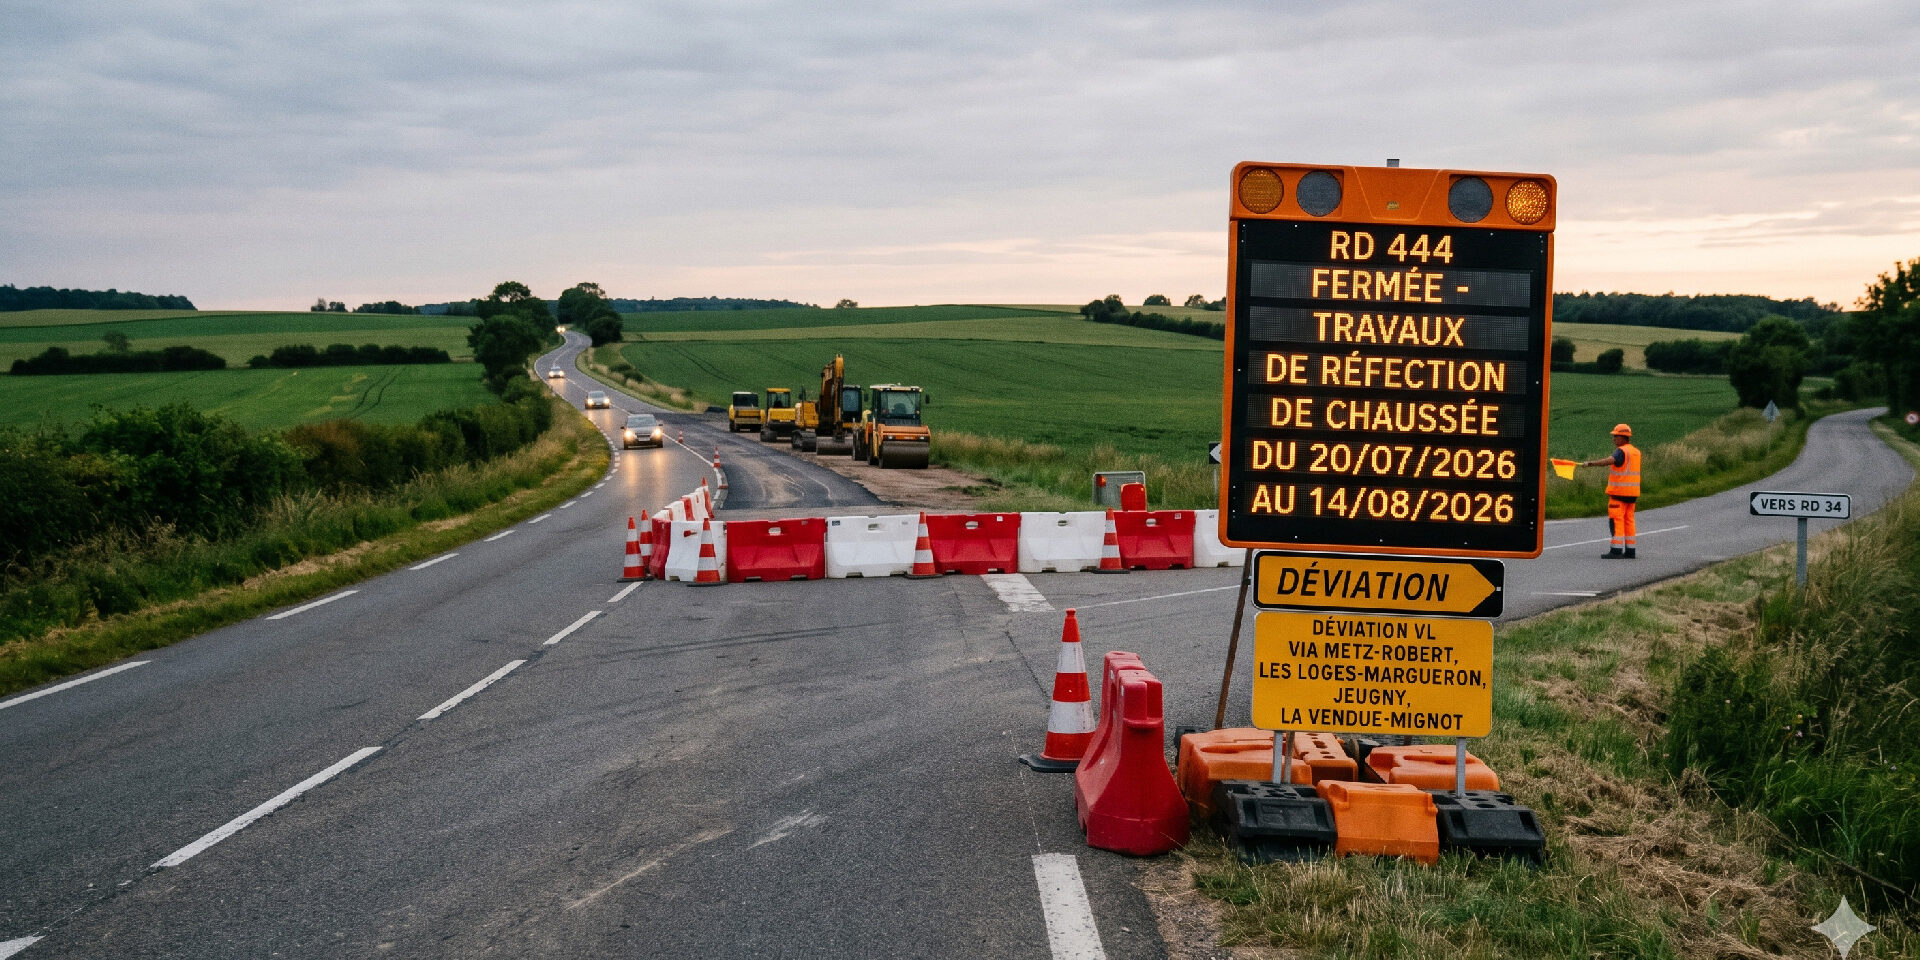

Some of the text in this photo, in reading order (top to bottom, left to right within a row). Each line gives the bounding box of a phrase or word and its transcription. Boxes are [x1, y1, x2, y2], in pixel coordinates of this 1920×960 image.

[1330, 230, 1454, 264] RD 444
[1312, 267, 1444, 303] FERMÉE
[1313, 311, 1466, 348] TRAVAUX
[1266, 351, 1505, 391] DE RÉFECTION
[1270, 397, 1499, 435] DE CHAUSSÉE
[1251, 440, 1516, 479] DU 20/07/2026
[1250, 484, 1514, 522] AU 14/08/2026
[1761, 499, 1842, 512] VERS RD 34
[1277, 562, 1449, 601] DÉVIATION
[1312, 616, 1436, 641] DÉVIATION VL
[1288, 640, 1459, 666] VIA METZ-ROBERT,
[1259, 661, 1487, 689] LES LOGES-MARGUERON,
[1333, 687, 1412, 708] JEUGNY,
[1281, 707, 1463, 731] LA VENDUE-MIGNOT
